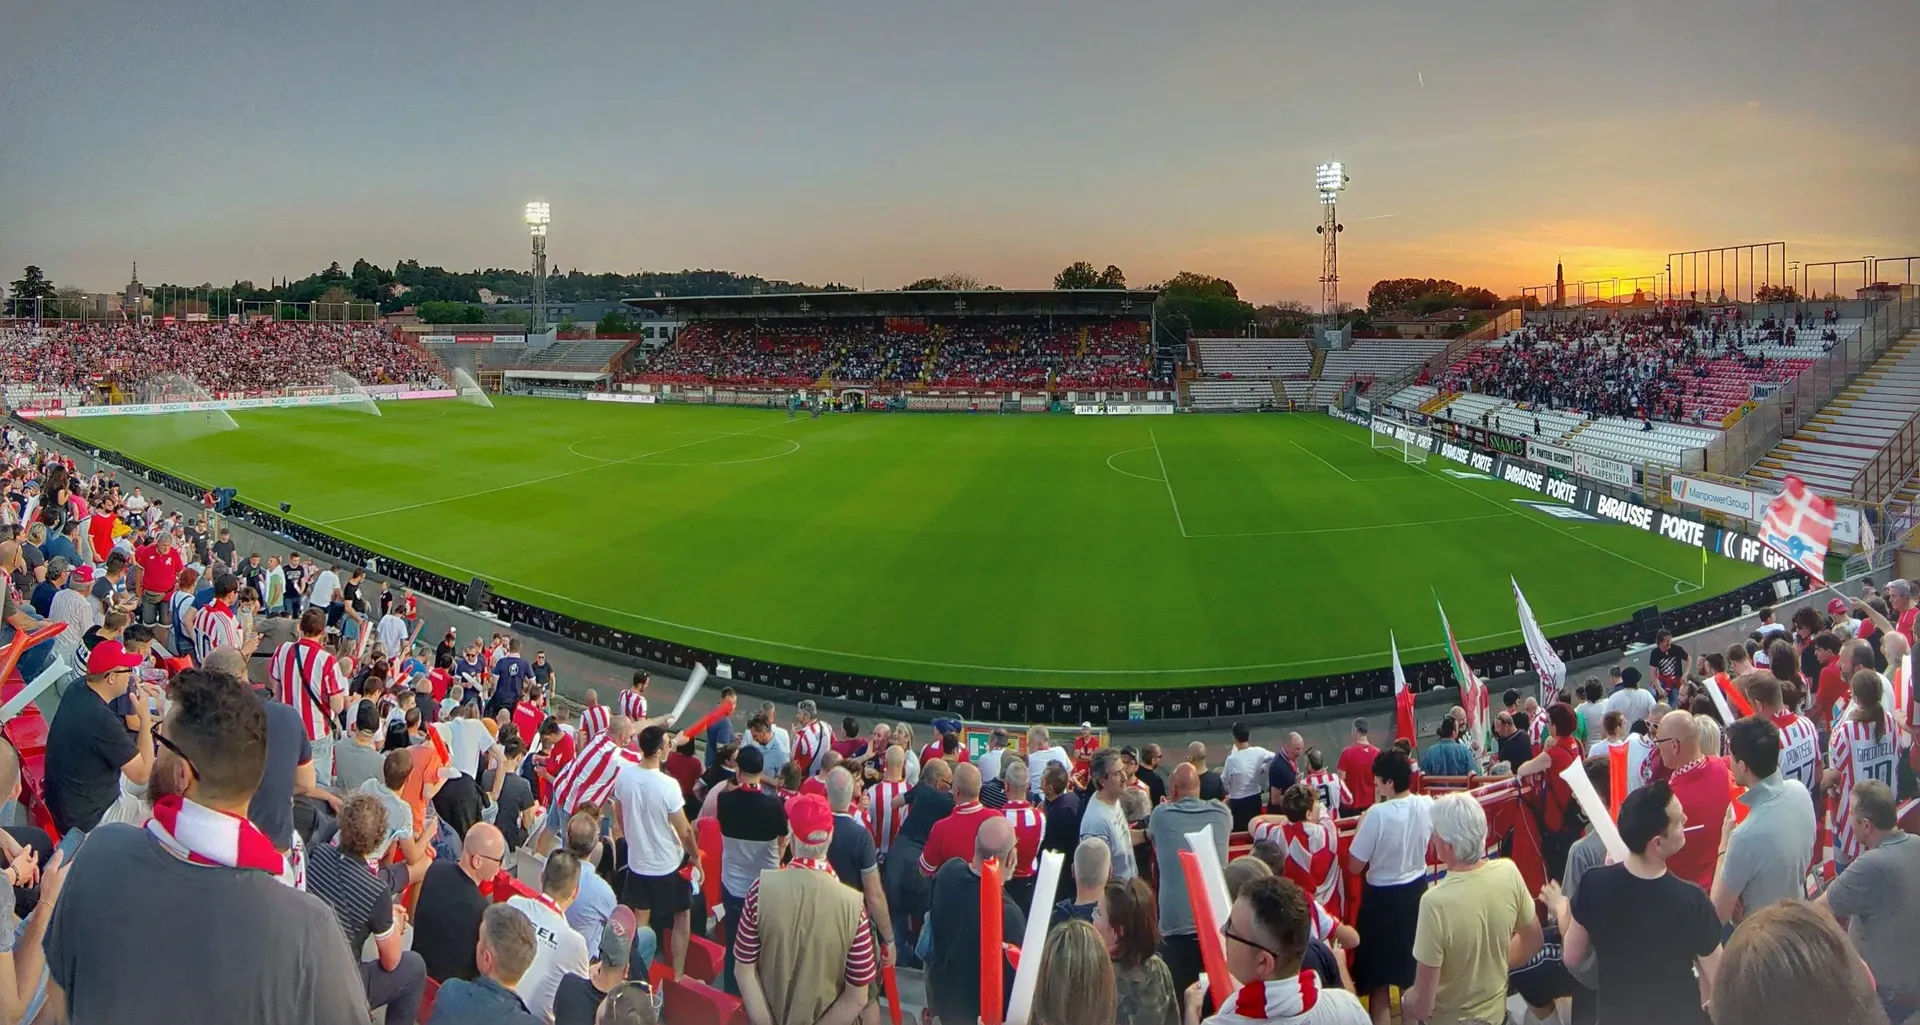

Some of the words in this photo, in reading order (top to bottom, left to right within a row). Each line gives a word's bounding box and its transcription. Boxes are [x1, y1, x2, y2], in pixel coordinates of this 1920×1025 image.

[1440, 442, 1470, 465] BARAUSSE
[1470, 452, 1493, 473] PORTE
[1591, 457, 1625, 474] ALDATURA
[1504, 464, 1544, 492] BARAUSSE
[1546, 477, 1577, 504] PORTE
[1688, 487, 1750, 512] ManpowerGroup
[1597, 494, 1653, 531] BARAUSSE
[1659, 513, 1705, 547] PORTE
[1741, 537, 1761, 563] RF
[1863, 759, 1892, 788] 10
